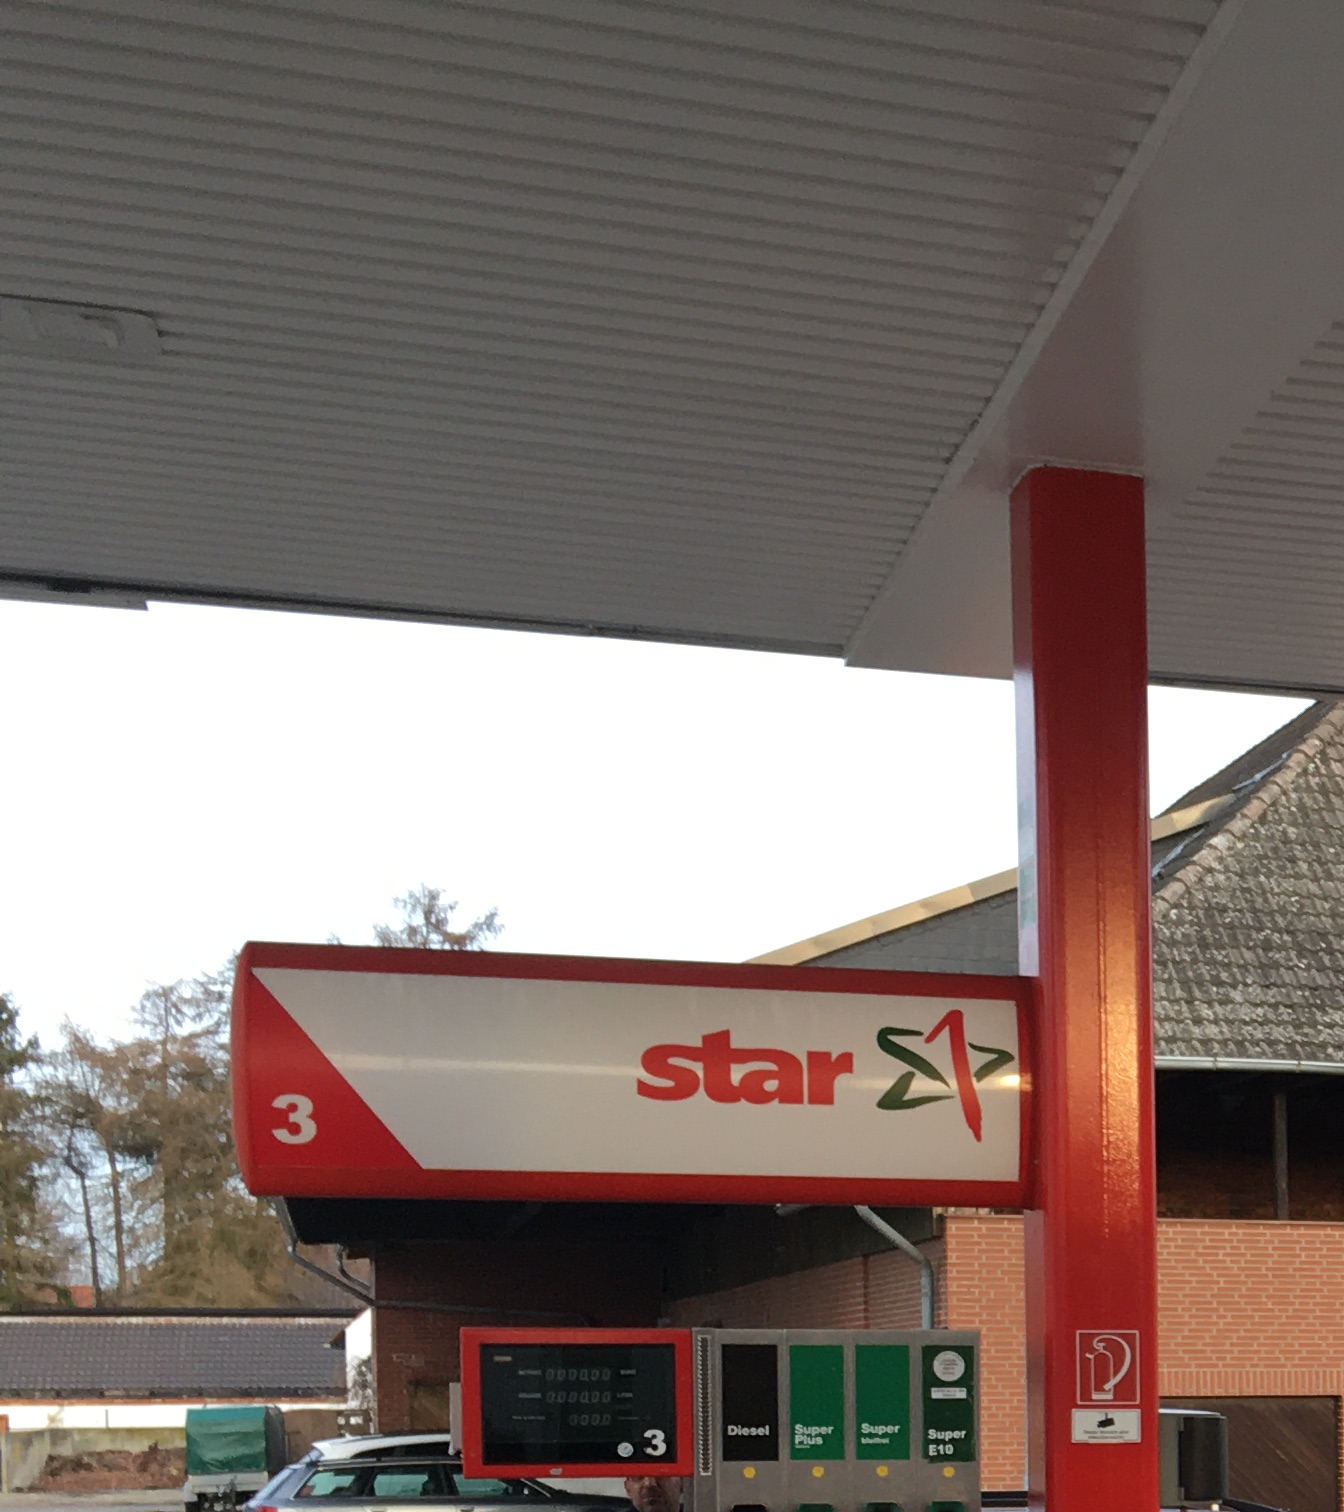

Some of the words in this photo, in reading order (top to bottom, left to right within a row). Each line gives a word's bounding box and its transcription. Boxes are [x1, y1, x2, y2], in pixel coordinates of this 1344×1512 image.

[636, 1028, 854, 1106] star
[270, 1093, 318, 1146] 3
[727, 1424, 770, 1436] Diesel
[794, 1423, 834, 1436] Super
[861, 1422, 900, 1436] Super
[927, 1428, 967, 1442] Super
[643, 1428, 667, 1456] 3
[794, 1435, 823, 1445] Plus
[928, 1444, 954, 1456] E10
